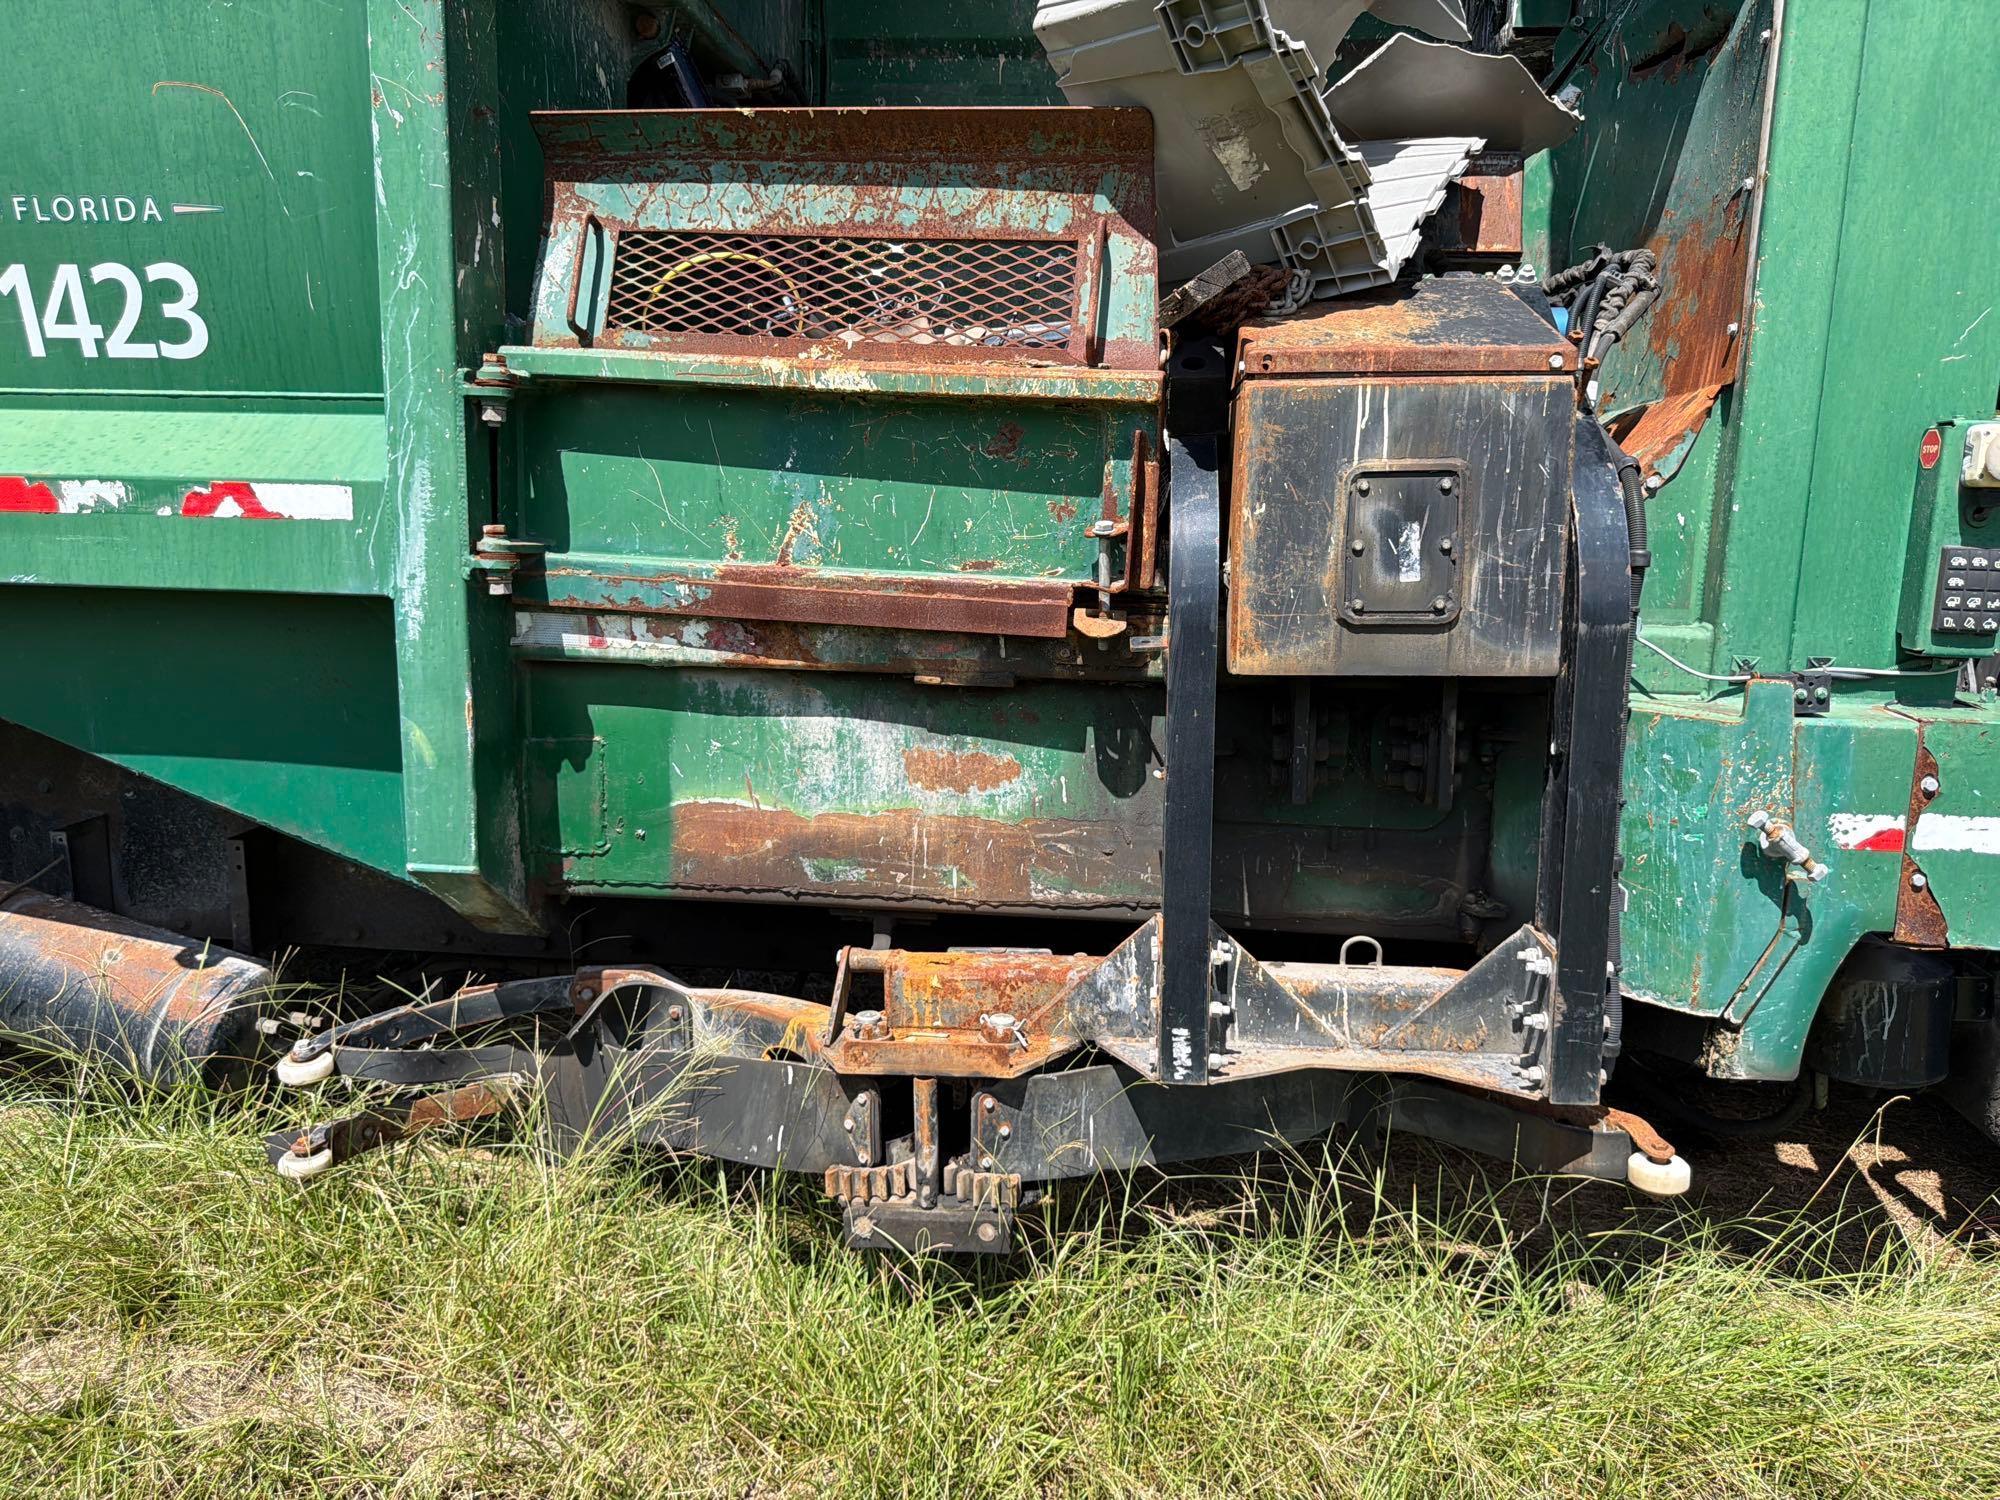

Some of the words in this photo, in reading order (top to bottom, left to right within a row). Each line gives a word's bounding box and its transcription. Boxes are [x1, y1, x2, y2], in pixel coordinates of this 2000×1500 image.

[12, 196, 163, 222] FLORIDA
[0, 261, 209, 360] 1423
[1922, 444, 1939, 454] STOP
